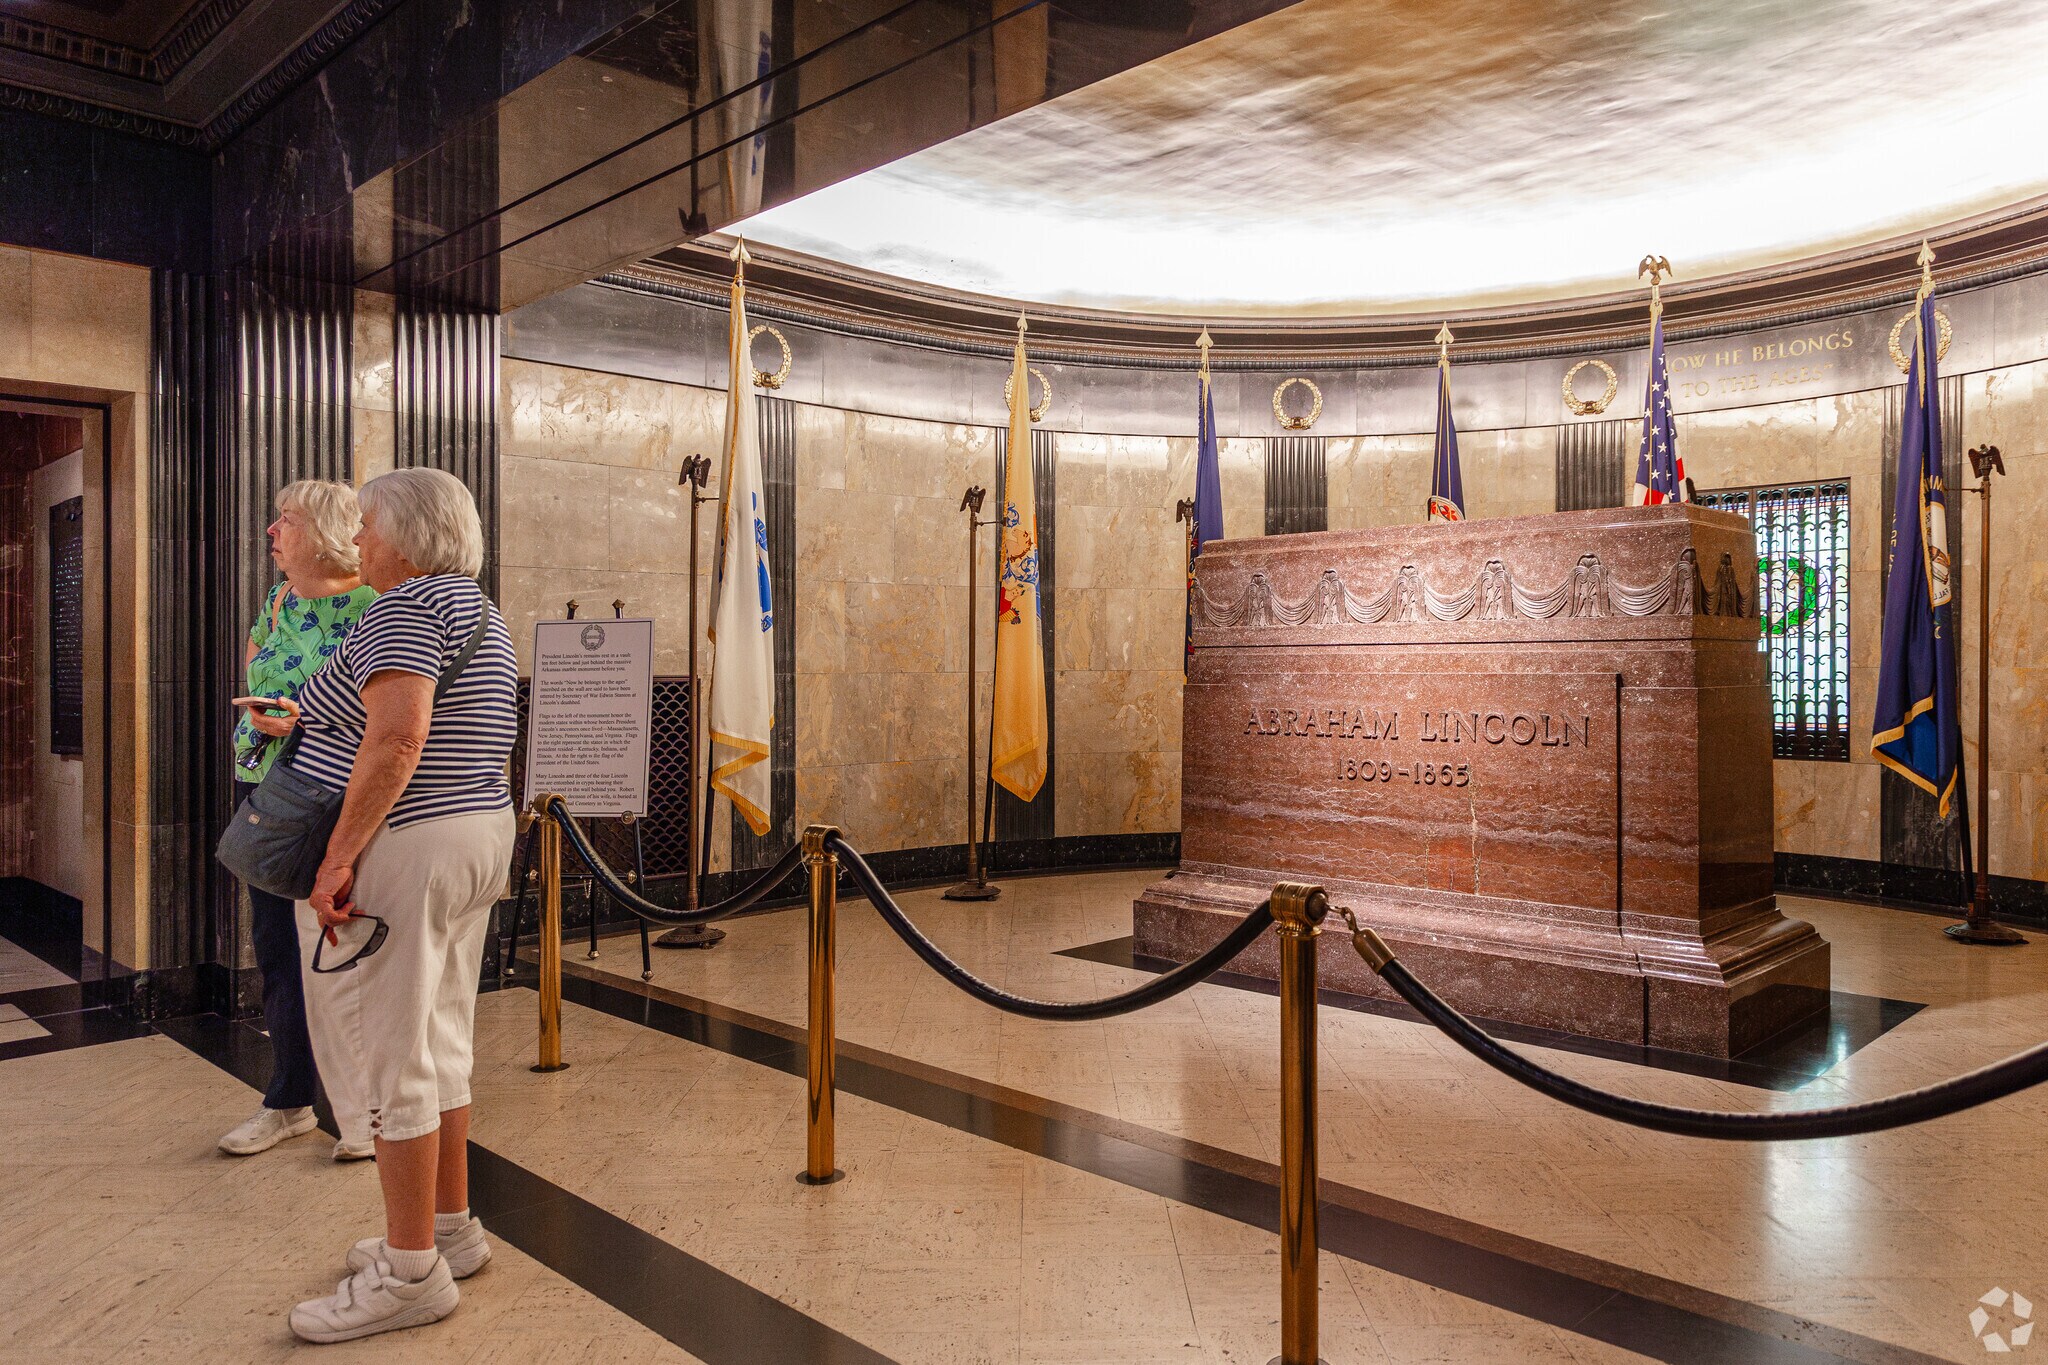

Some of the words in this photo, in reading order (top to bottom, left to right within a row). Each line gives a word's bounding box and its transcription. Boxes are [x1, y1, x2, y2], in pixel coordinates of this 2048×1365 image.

[1715, 348, 1743, 367] HE
[1752, 330, 1853, 362] BELONGS
[1681, 381, 1710, 398] TO
[1718, 373, 1759, 394] THE
[1244, 707, 1399, 740] ABRAHAM
[1421, 711, 1590, 748] LINCOLN
